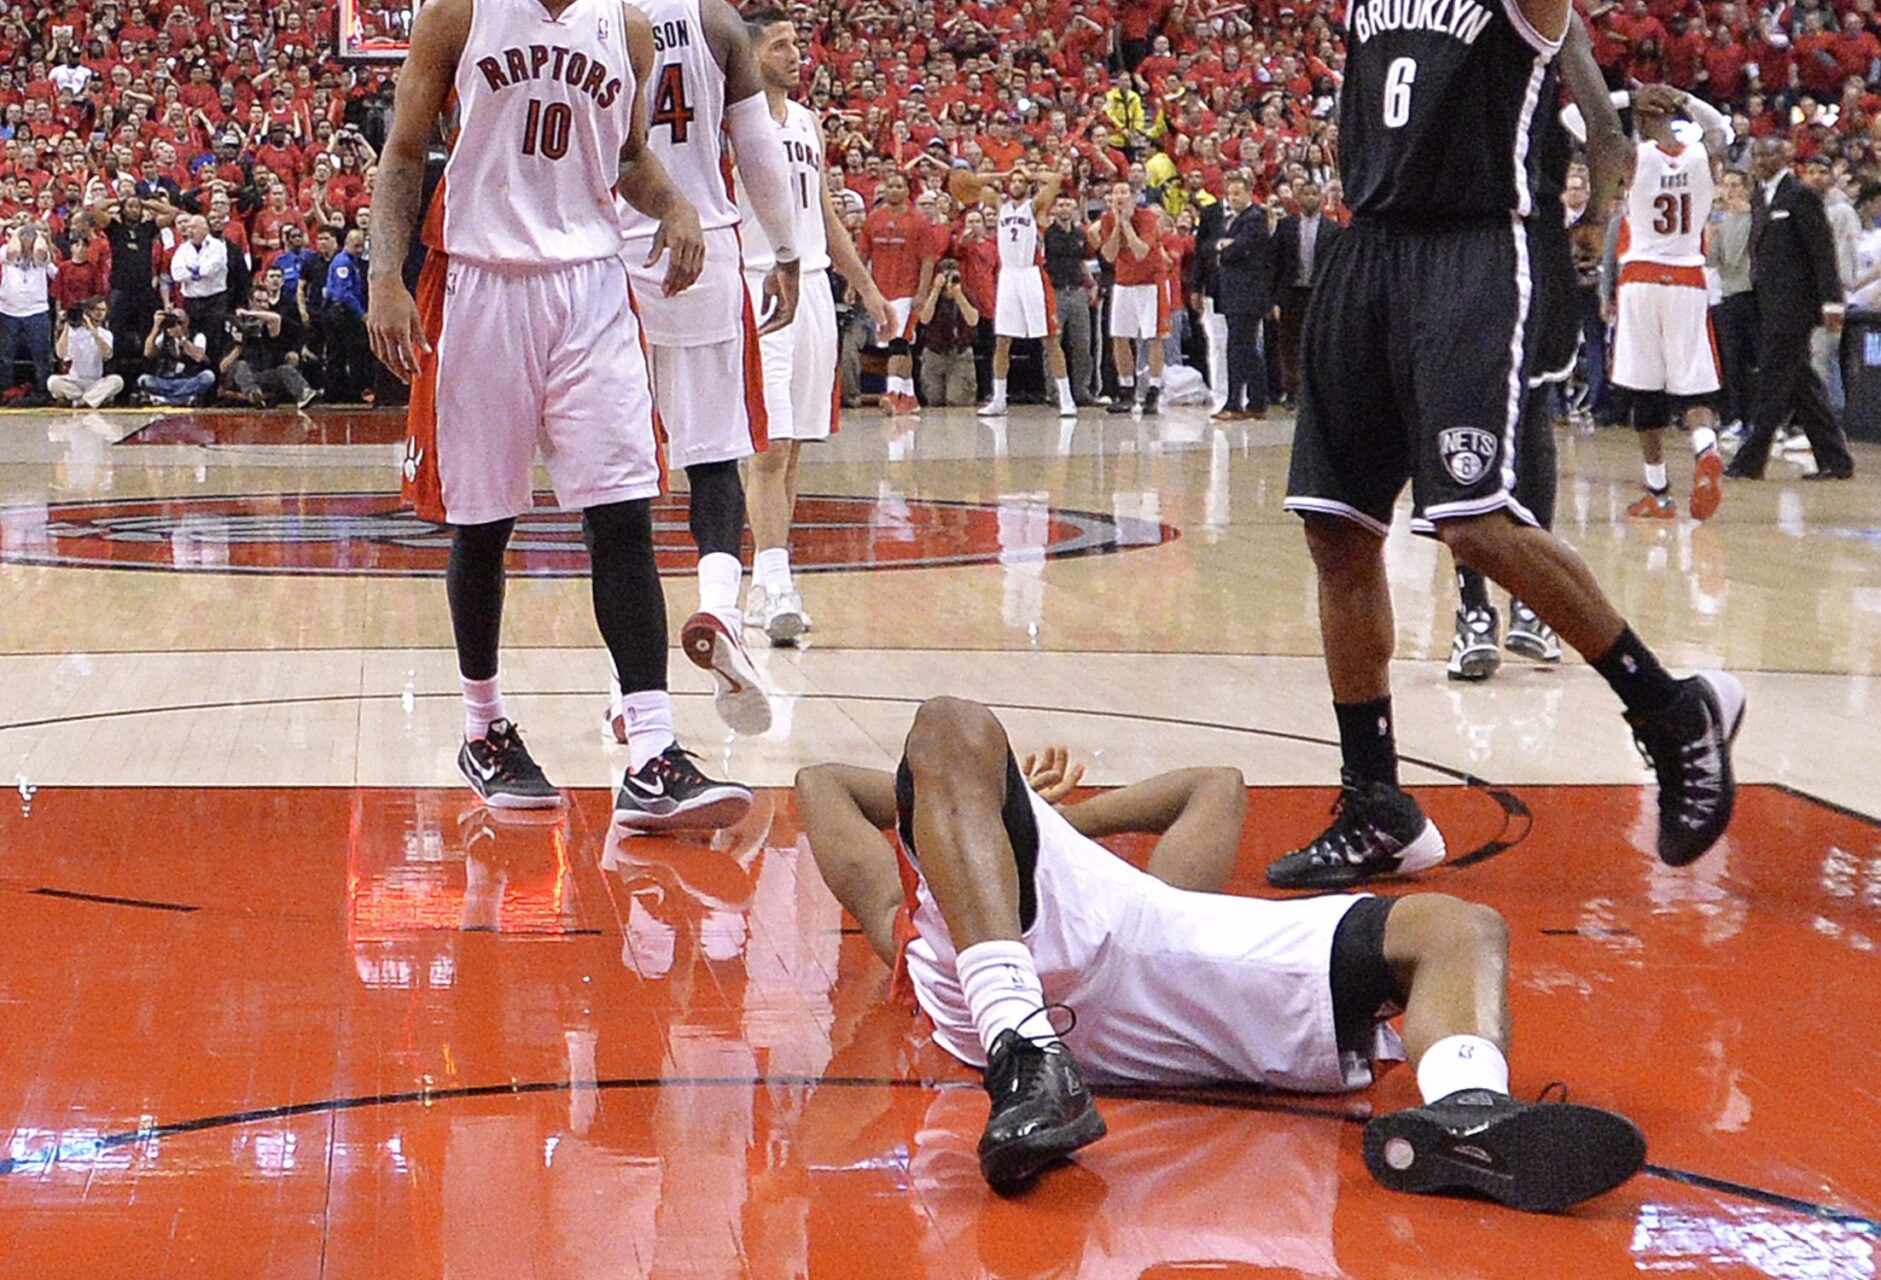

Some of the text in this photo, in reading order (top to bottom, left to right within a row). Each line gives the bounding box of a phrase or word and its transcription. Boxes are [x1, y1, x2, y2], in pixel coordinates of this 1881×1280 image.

[652, 19, 689, 52] SON
[477, 44, 622, 109] RAPTORS
[650, 62, 694, 144] 4
[1382, 56, 1417, 129] 6
[521, 98, 572, 161] 10
[1010, 227, 1019, 241] 2
[1653, 192, 1691, 236] 31
[1442, 431, 1495, 456] NETS
